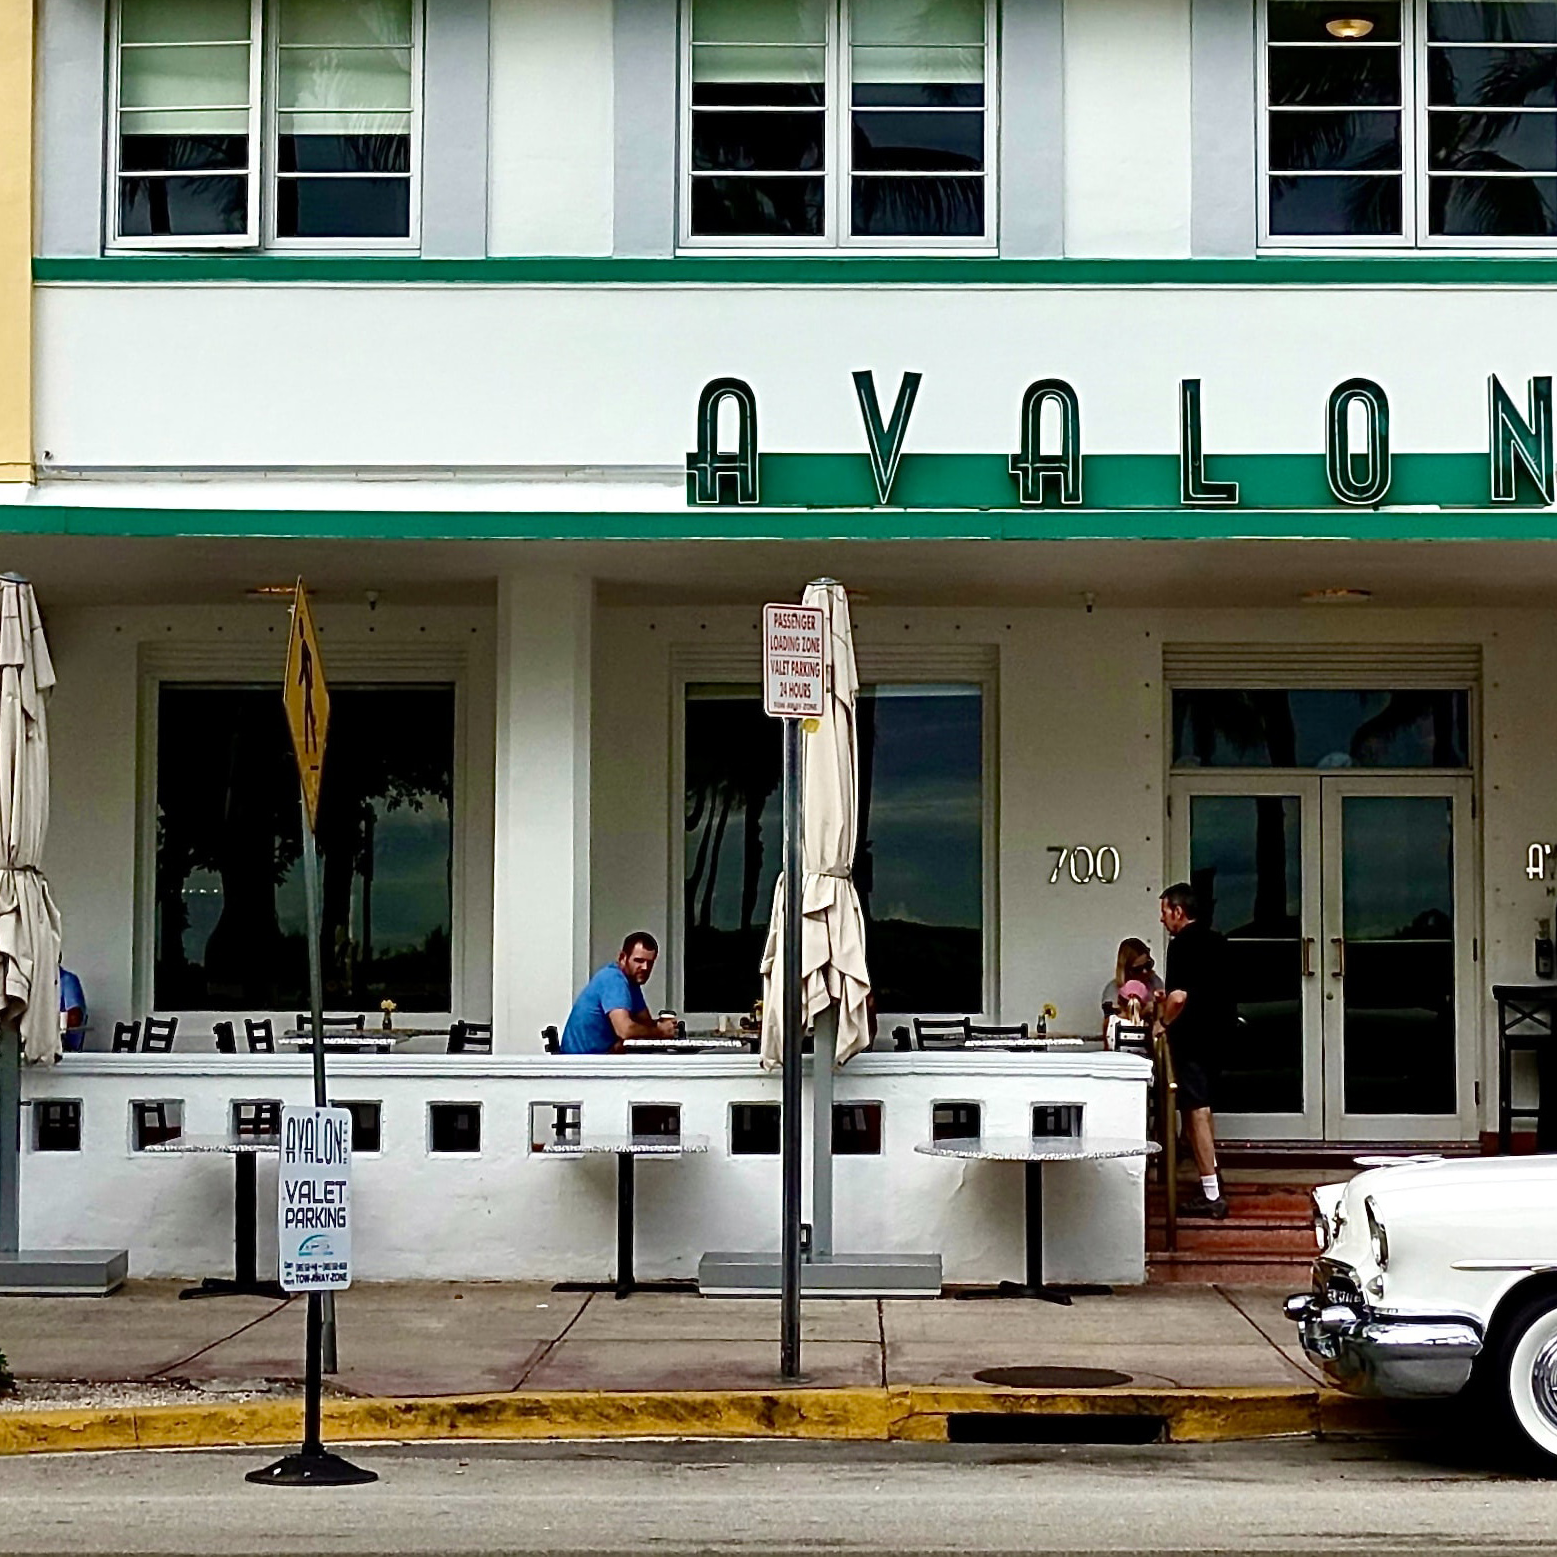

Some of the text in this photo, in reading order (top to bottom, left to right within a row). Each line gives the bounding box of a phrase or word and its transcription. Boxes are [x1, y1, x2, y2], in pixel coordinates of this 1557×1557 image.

[686, 370, 1555, 509] AVALON
[773, 612, 816, 631] PASSENGER
[770, 635, 820, 653] LOADING ZONE
[770, 660, 820, 678] VALET PARKING
[779, 681, 811, 699] 24 HOURS
[1046, 845, 1121, 884] 700
[286, 1117, 343, 1164] AVALON
[285, 1180, 346, 1204] VALET
[285, 1208, 346, 1229] PARKING
